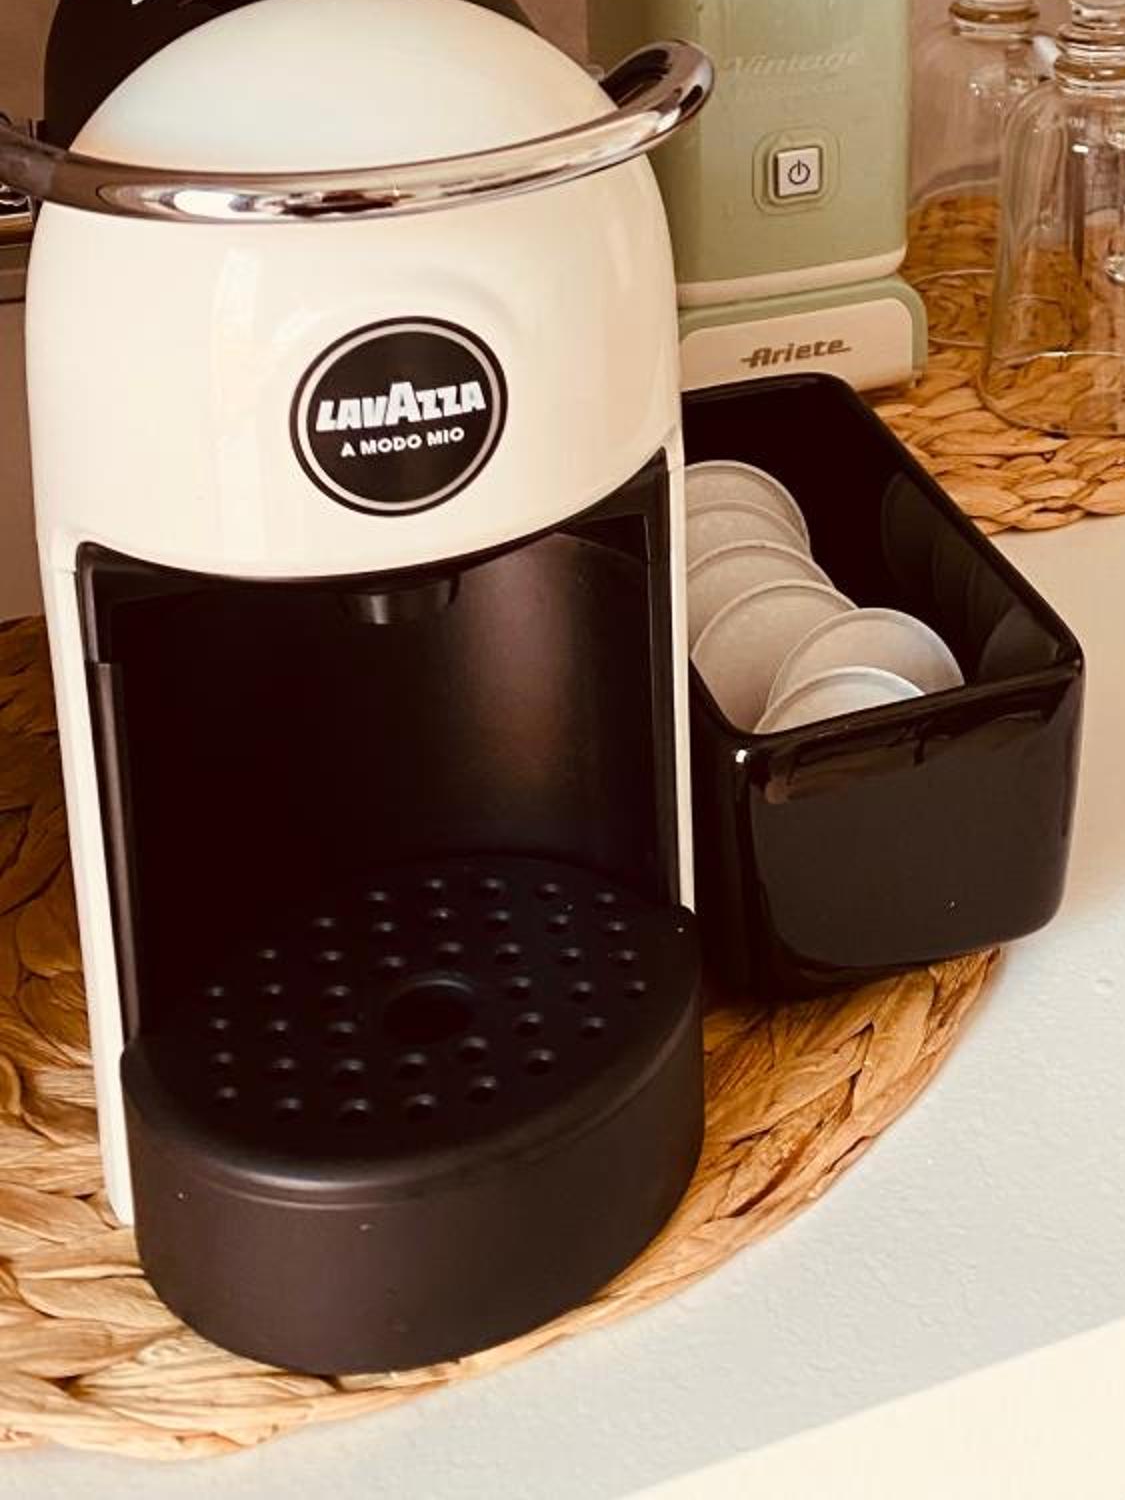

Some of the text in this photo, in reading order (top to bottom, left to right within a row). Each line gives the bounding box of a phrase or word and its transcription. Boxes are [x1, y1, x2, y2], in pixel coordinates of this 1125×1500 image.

[741, 338, 853, 368] Ariete
[315, 381, 486, 432] LAVAZZA
[340, 427, 465, 458] A MODO MIO
